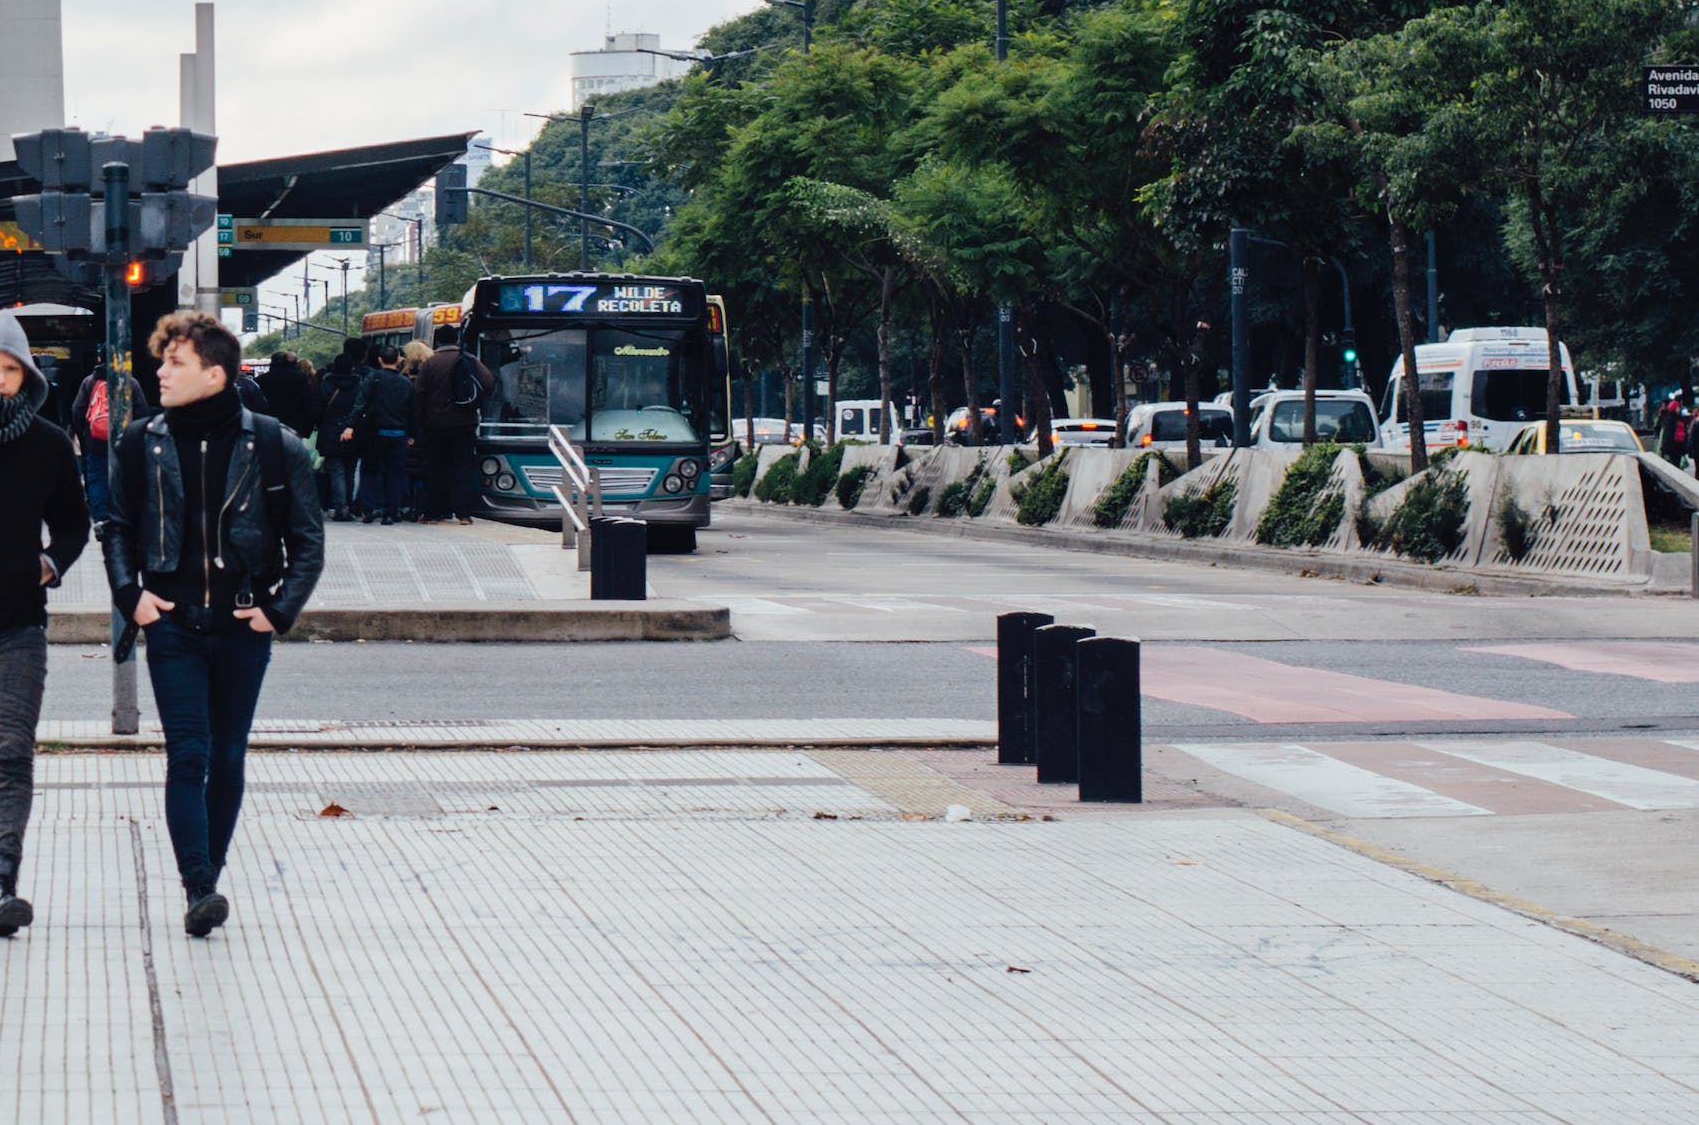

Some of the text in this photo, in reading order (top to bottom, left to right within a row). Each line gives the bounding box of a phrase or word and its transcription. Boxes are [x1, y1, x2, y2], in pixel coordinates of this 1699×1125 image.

[1648, 69, 1699, 81] Avenida
[1648, 98, 1677, 109] 1050
[219, 217, 229, 225] 10
[244, 230, 263, 239] Sur
[338, 231, 352, 242] 10
[219, 248, 230, 256] 59
[523, 284, 598, 313] 17
[613, 286, 665, 300] WILDE
[597, 299, 682, 313] RECOLETA
[433, 306, 460, 324] 59
